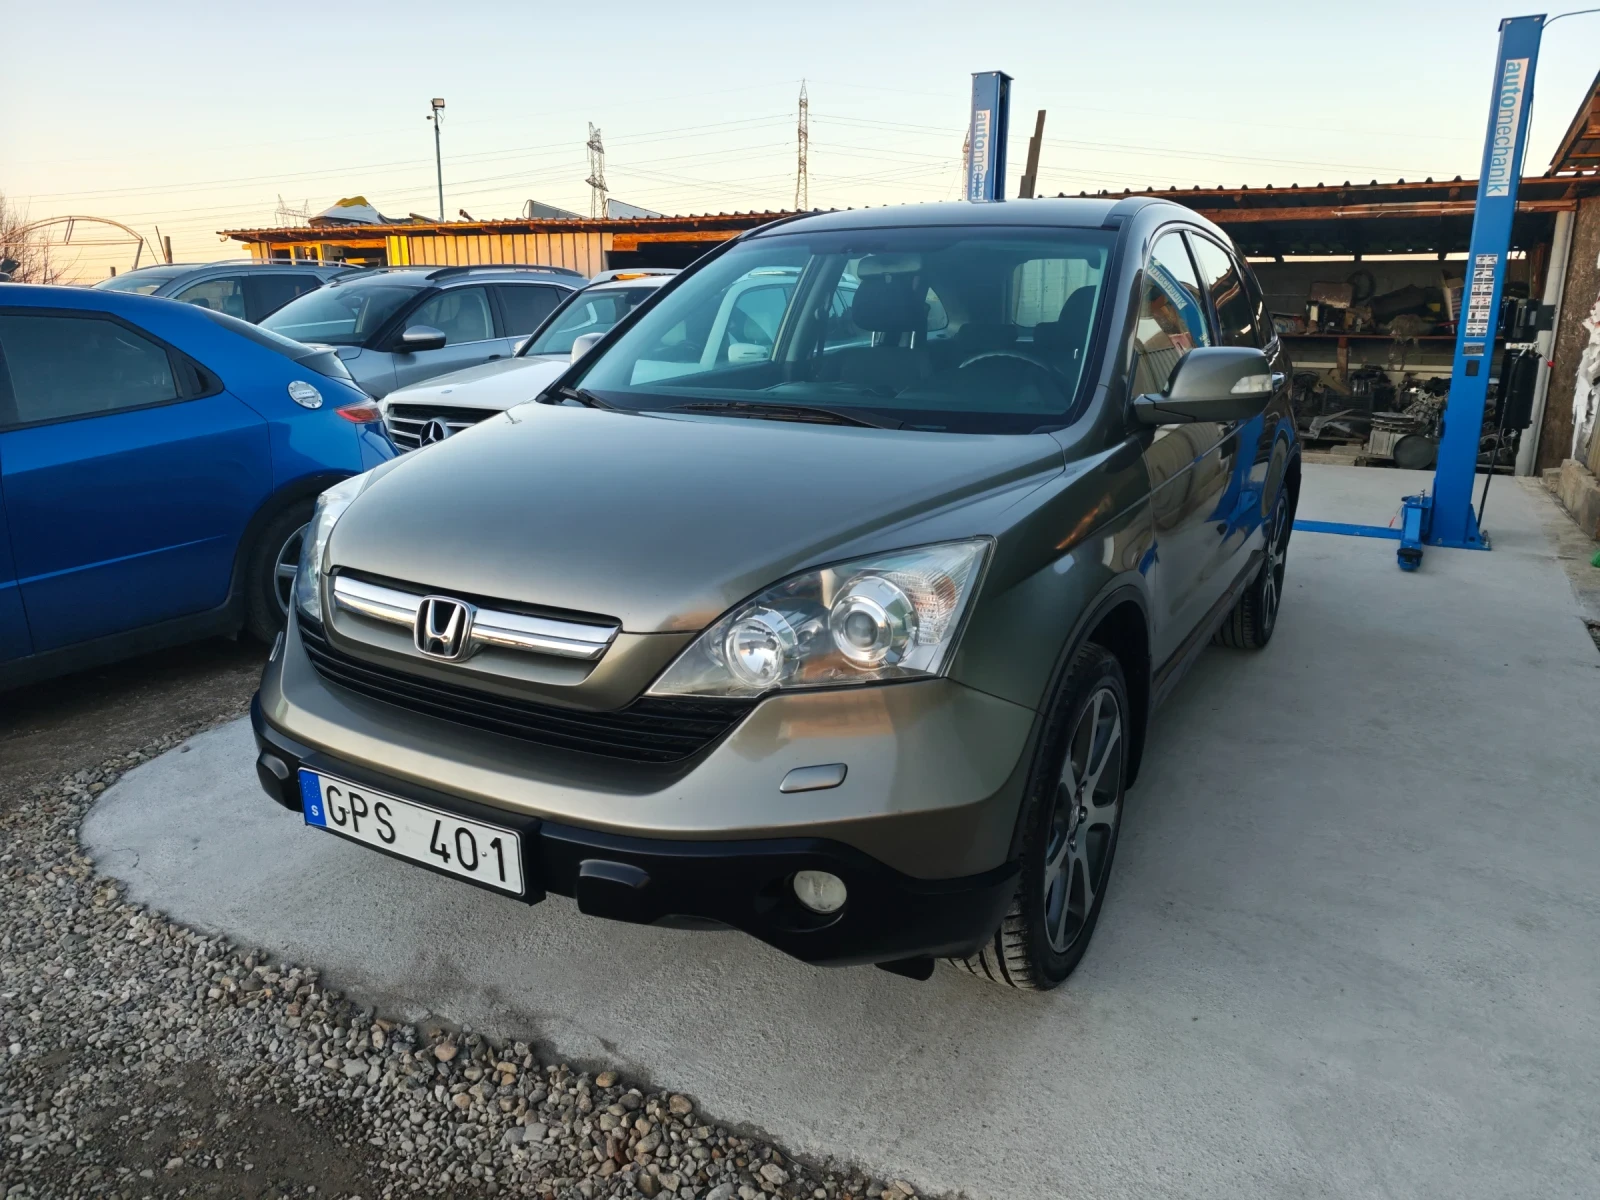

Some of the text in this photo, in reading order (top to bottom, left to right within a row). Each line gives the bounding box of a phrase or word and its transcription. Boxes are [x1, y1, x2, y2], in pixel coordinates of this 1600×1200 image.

[972, 111, 988, 200] automecha
[1487, 62, 1522, 193] automechanik
[311, 805, 319, 816] S
[326, 785, 506, 882] GPS 401
